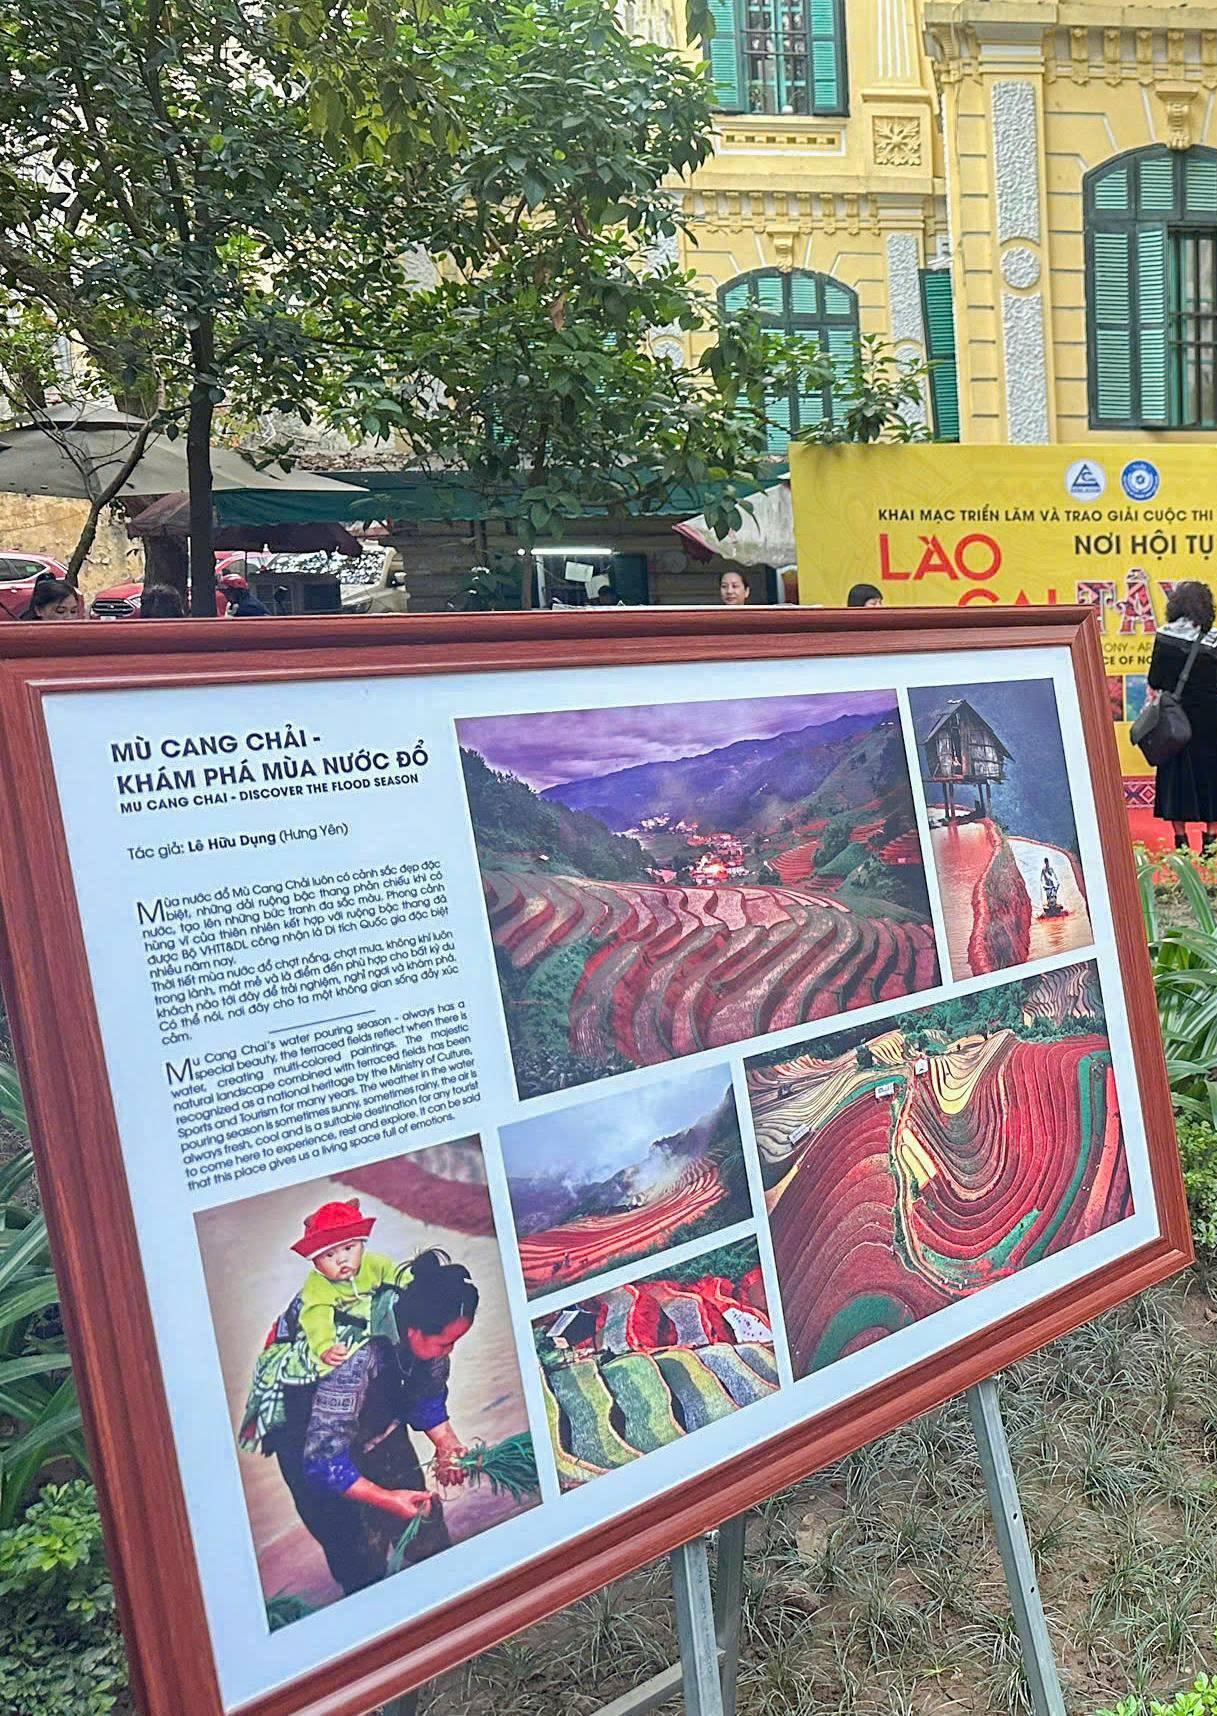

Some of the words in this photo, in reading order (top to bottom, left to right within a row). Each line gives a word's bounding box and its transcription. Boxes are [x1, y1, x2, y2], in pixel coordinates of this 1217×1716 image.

[878, 509, 914, 521] KHAI
[920, 509, 955, 524] MẠC
[960, 504, 999, 521] TRIỂN
[1005, 507, 1034, 521] LÃM
[1040, 508, 1060, 521] VÀ
[1065, 510, 1102, 522] TRAO
[1107, 507, 1138, 522] GIẢI
[1143, 507, 1187, 525] CUỘC
[1193, 510, 1213, 521] THI
[879, 533, 1002, 581] LÀO
[1074, 534, 1121, 555] NƠI
[1131, 529, 1176, 560] HỘI
[1186, 535, 1214, 560] TỤ
[1076, 566, 1178, 635] TÂ
[1119, 656, 1133, 665] OF
[110, 736, 152, 763] MÙ
[161, 734, 238, 760] CANG
[245, 723, 307, 754] CHẢI
[116, 766, 196, 796] KHÁM
[205, 760, 256, 788] PHÁ
[262, 756, 317, 782] MÙA
[323, 749, 389, 776] NƯỚC
[396, 739, 429, 767] ĐỔ
[120, 801, 142, 814] MU
[146, 797, 189, 810] CANG
[193, 792, 228, 806] CHAI
[239, 784, 303, 802] DISCOVER
[306, 781, 329, 794] THE
[332, 777, 371, 792] FLOOD
[374, 773, 419, 788] SEASON
[127, 844, 155, 860] Tác
[157, 841, 185, 860] giả:
[188, 837, 204, 853] Lê
[208, 833, 237, 851] Hữu
[239, 831, 276, 852] Dụng
[279, 827, 317, 847] (Hưng
[319, 822, 349, 842] Yên)
[170, 1083, 206, 1098] water,
[216, 1070, 264, 1087] creating
[272, 1050, 341, 1075] multi-colored
[349, 1040, 396, 1059] paintings.
[404, 1034, 422, 1044] The
[430, 1023, 469, 1039] majestic
[173, 1093, 214, 1112] natural
[215, 1081, 275, 1101] landscape
[276, 1065, 332, 1087] combined
[333, 1061, 355, 1074] with
[356, 1050, 400, 1068] terraced
[401, 1045, 426, 1058] fields
[427, 1041, 444, 1051] has
[445, 1035, 471, 1047] been
[187, 1176, 211, 1190] that
[213, 1172, 232, 1183] this
[233, 1163, 266, 1180] place
[268, 1155, 296, 1171] gives
[298, 1152, 310, 1160] us
[321, 1141, 348, 1154] living
[349, 1133, 381, 1148] space
[381, 1126, 396, 1138] full
[397, 1123, 408, 1134] of
[409, 1112, 455, 1130] emotions.
